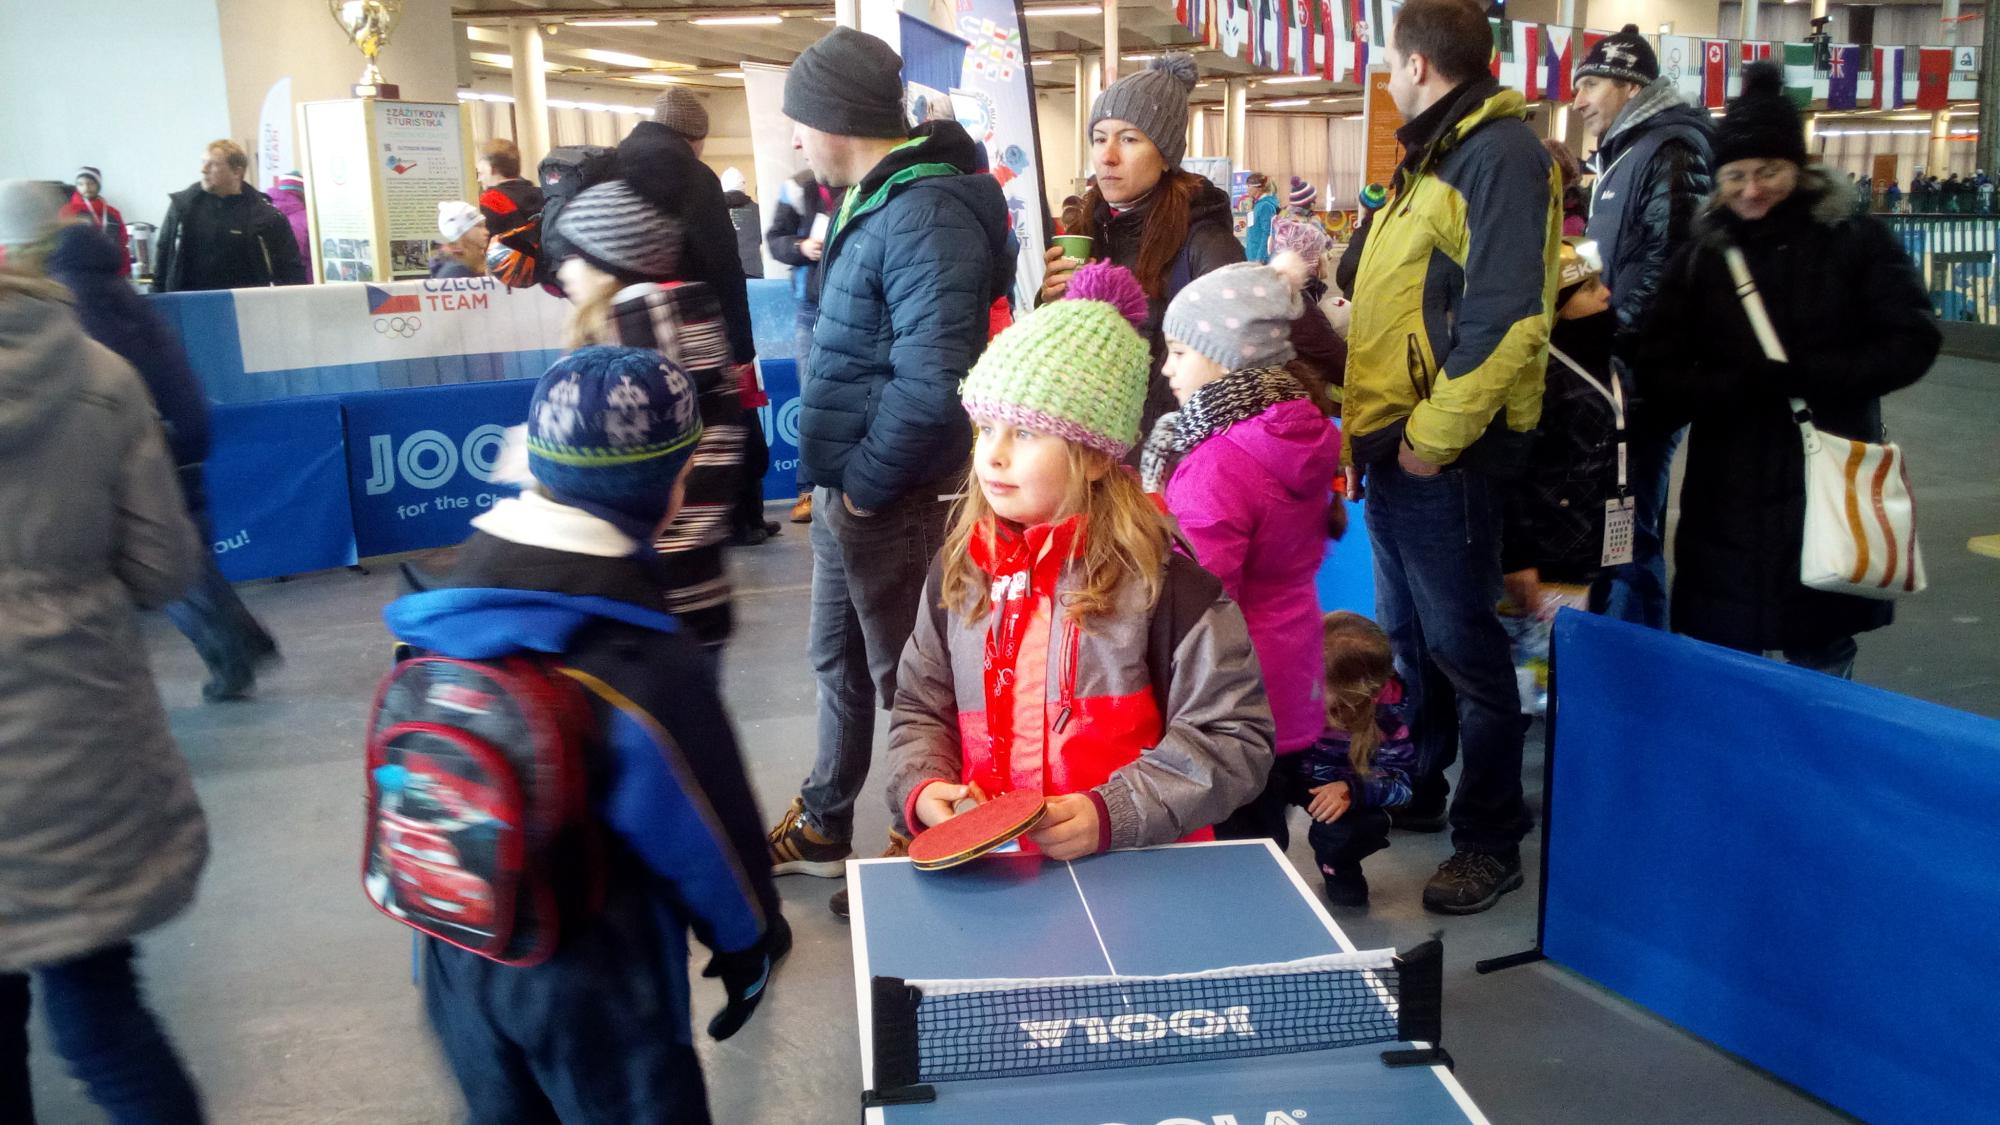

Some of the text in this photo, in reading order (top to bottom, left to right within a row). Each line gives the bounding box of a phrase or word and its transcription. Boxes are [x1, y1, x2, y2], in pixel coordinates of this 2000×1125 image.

[423, 277, 495, 292] CZECH
[426, 293, 488, 311] TEAM
[397, 500, 428, 520] for
[435, 494, 468, 511] the
[213, 529, 250, 553] ou!
[1016, 1005, 1255, 1048] JOOLA
